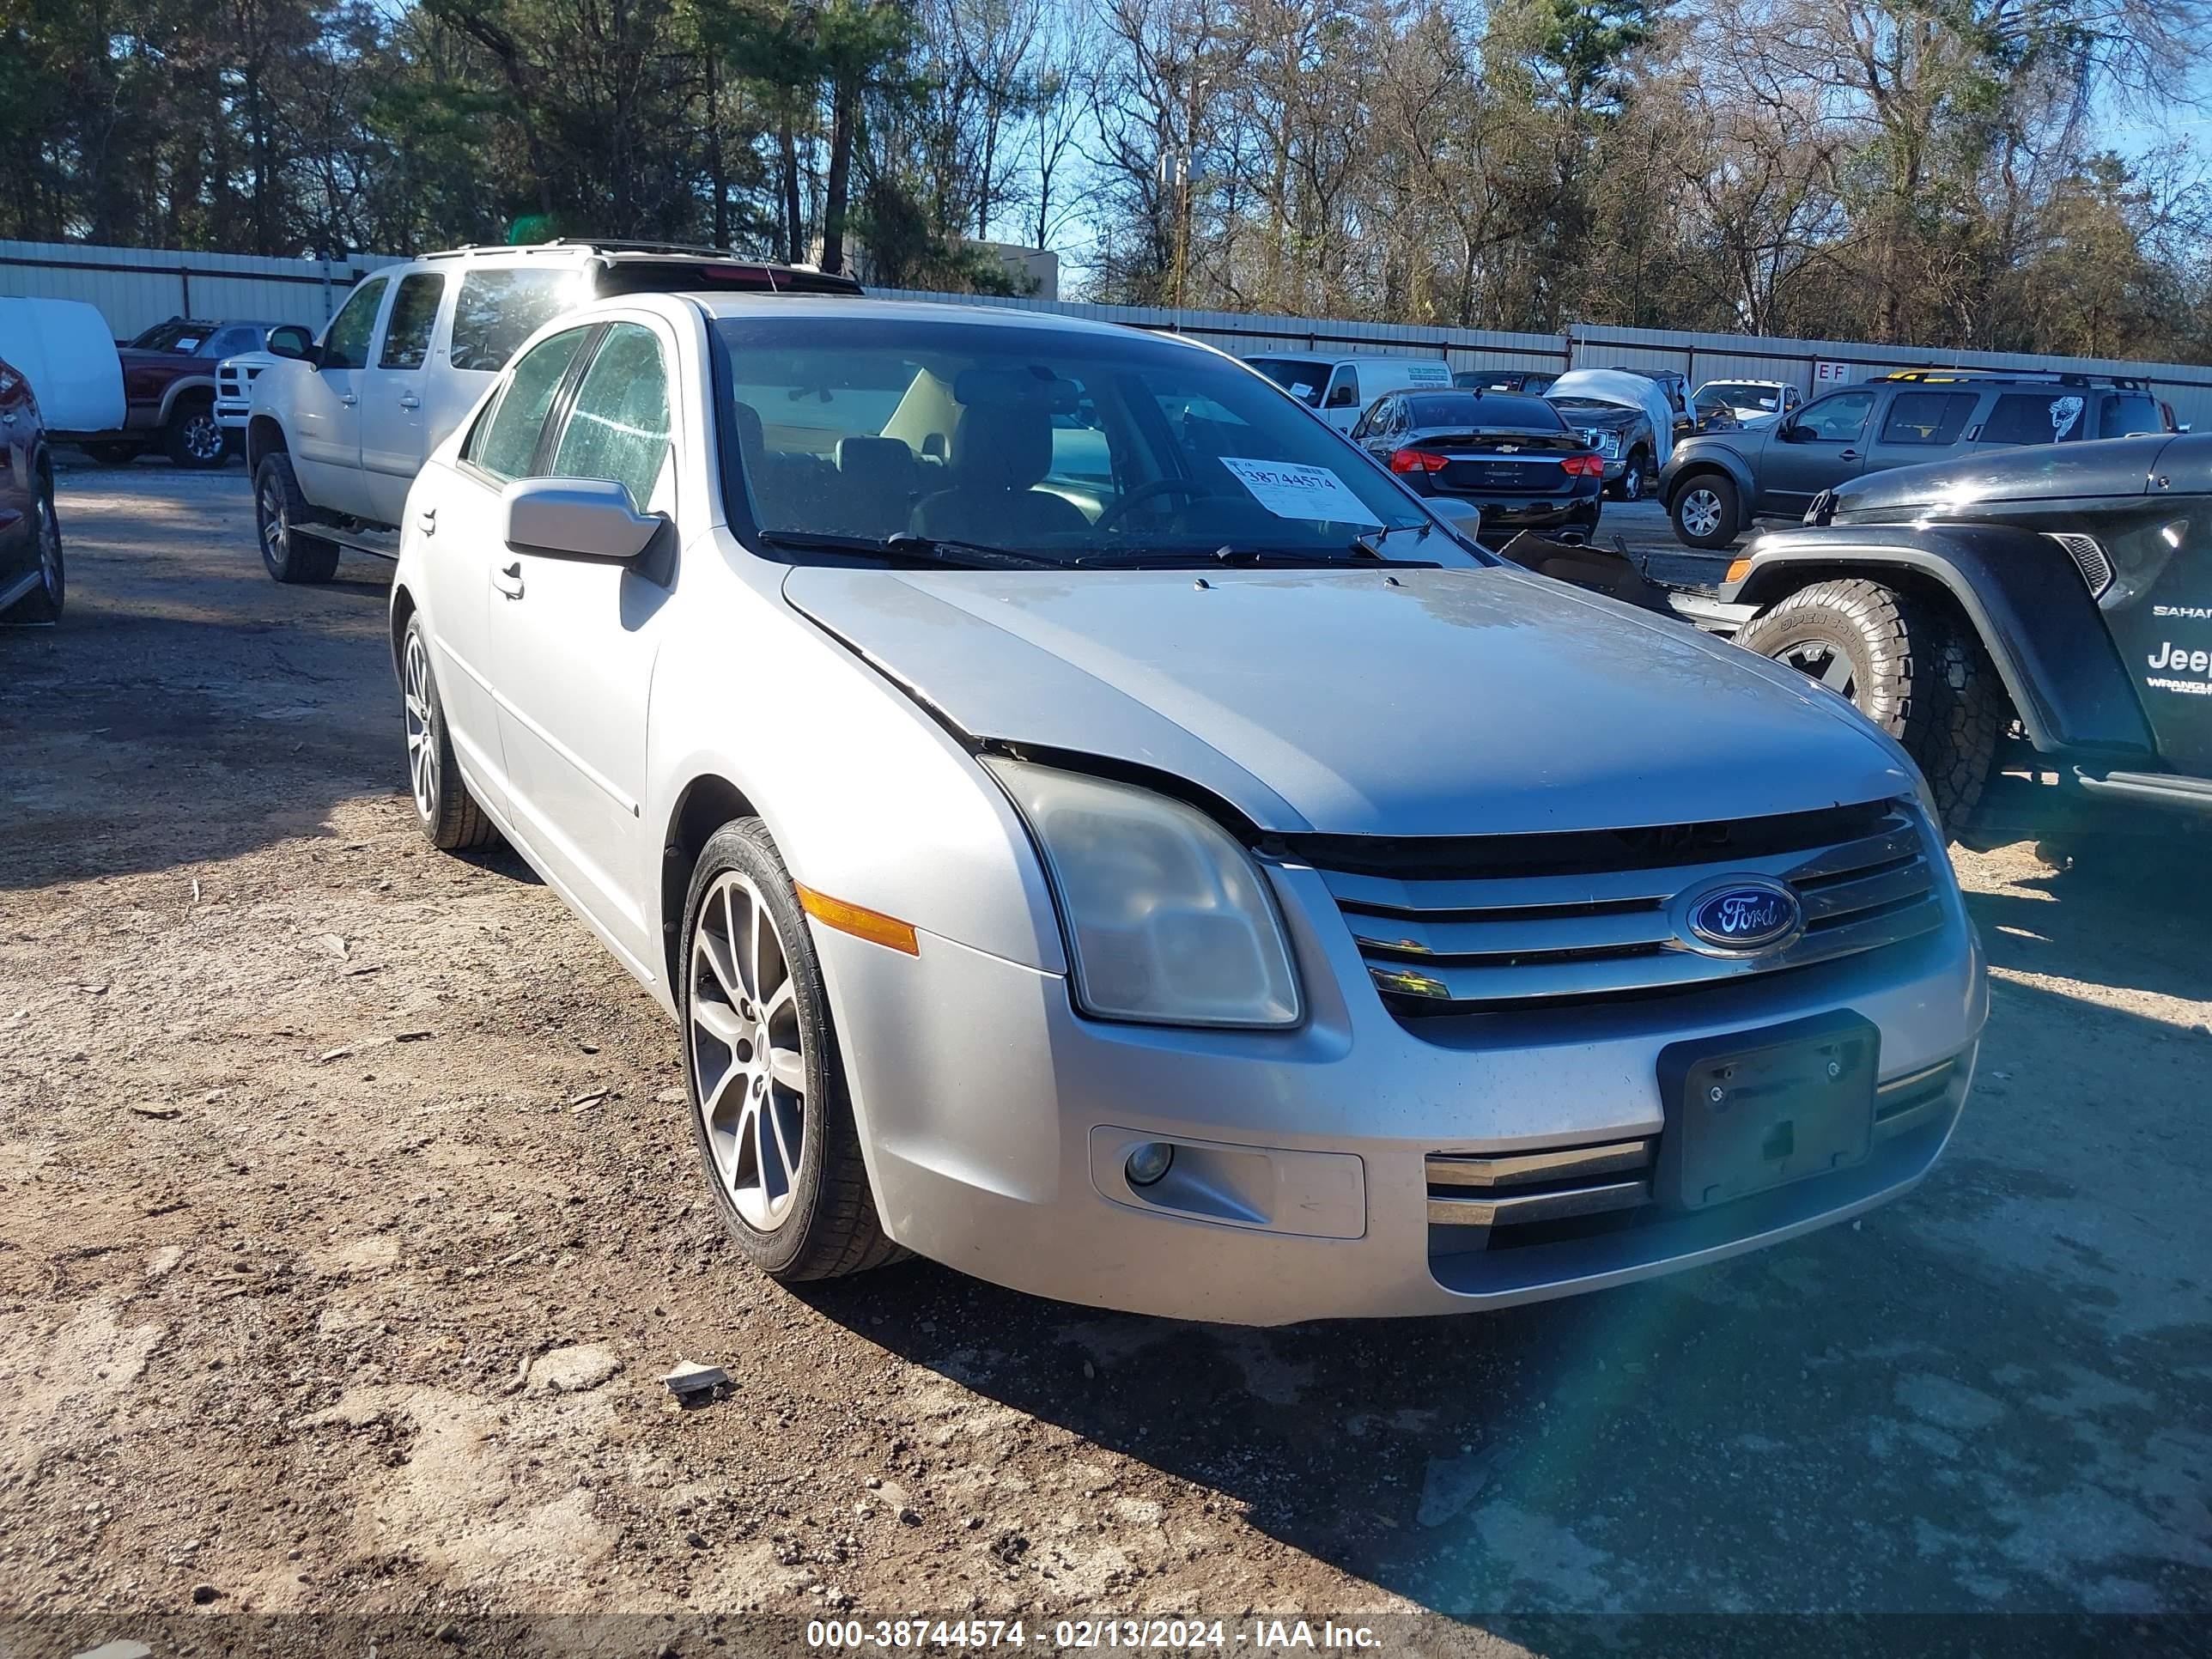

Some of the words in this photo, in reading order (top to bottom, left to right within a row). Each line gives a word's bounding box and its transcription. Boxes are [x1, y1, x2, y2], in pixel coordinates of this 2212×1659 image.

[1245, 470, 1336, 489] 38744574
[1780, 612, 1828, 632] OPEN
[2148, 641, 2212, 678] Jee
[1718, 896, 1778, 933] Ford
